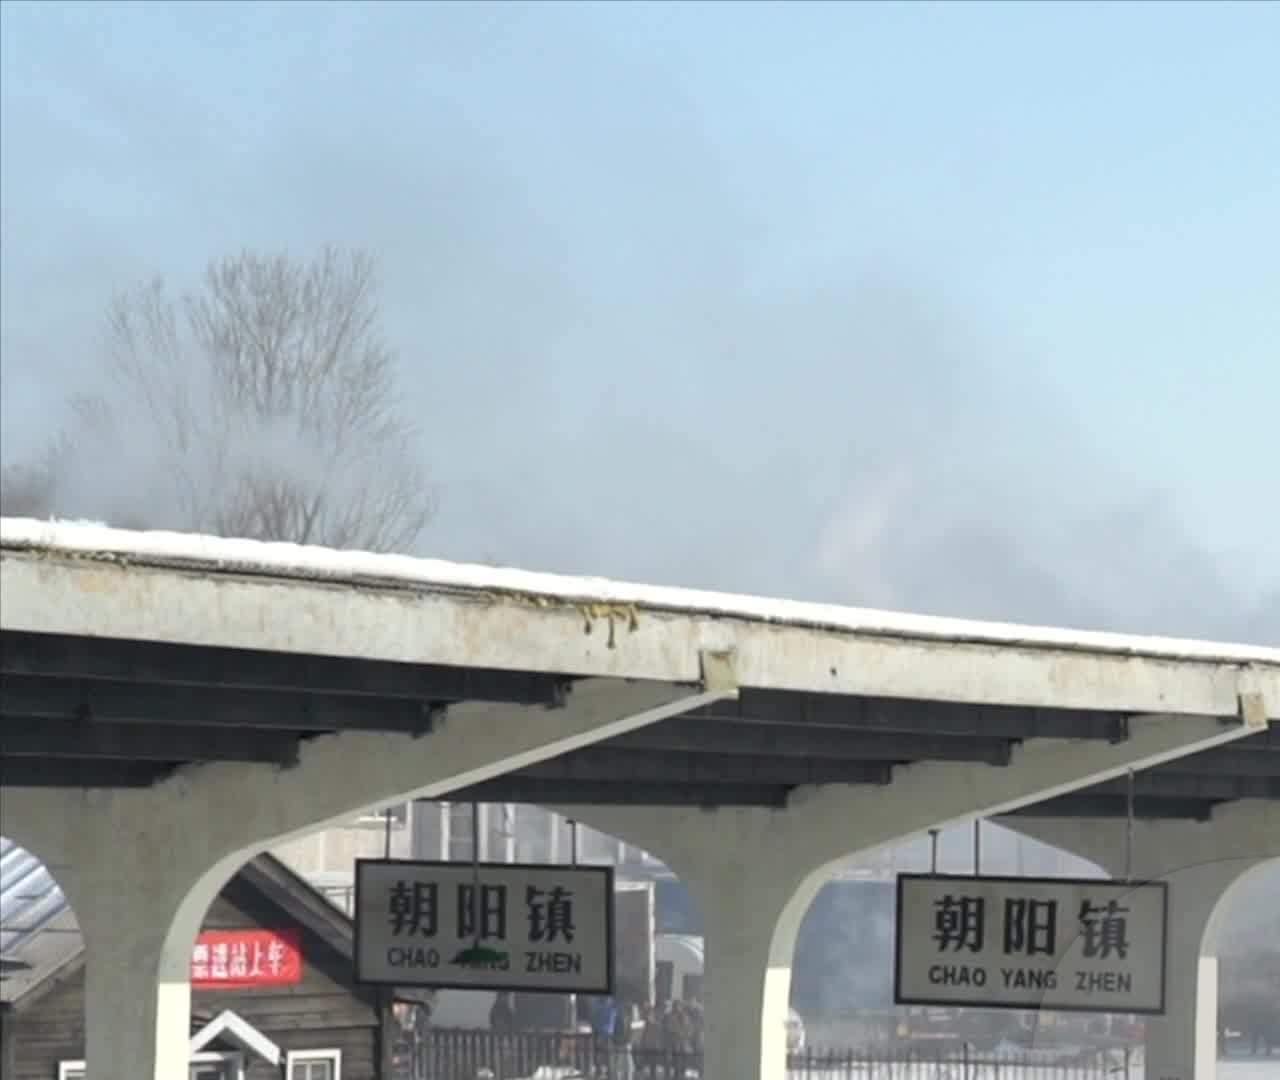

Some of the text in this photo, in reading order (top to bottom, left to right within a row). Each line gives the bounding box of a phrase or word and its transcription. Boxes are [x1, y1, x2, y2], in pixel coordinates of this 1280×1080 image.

[388, 880, 577, 944] 朝阳镇
[931, 895, 1130, 959] 朝阳镇
[387, 948, 440, 968] CHAO
[525, 952, 582, 974] ZHEN
[928, 965, 1131, 993] CHAO YANG ZHEN
